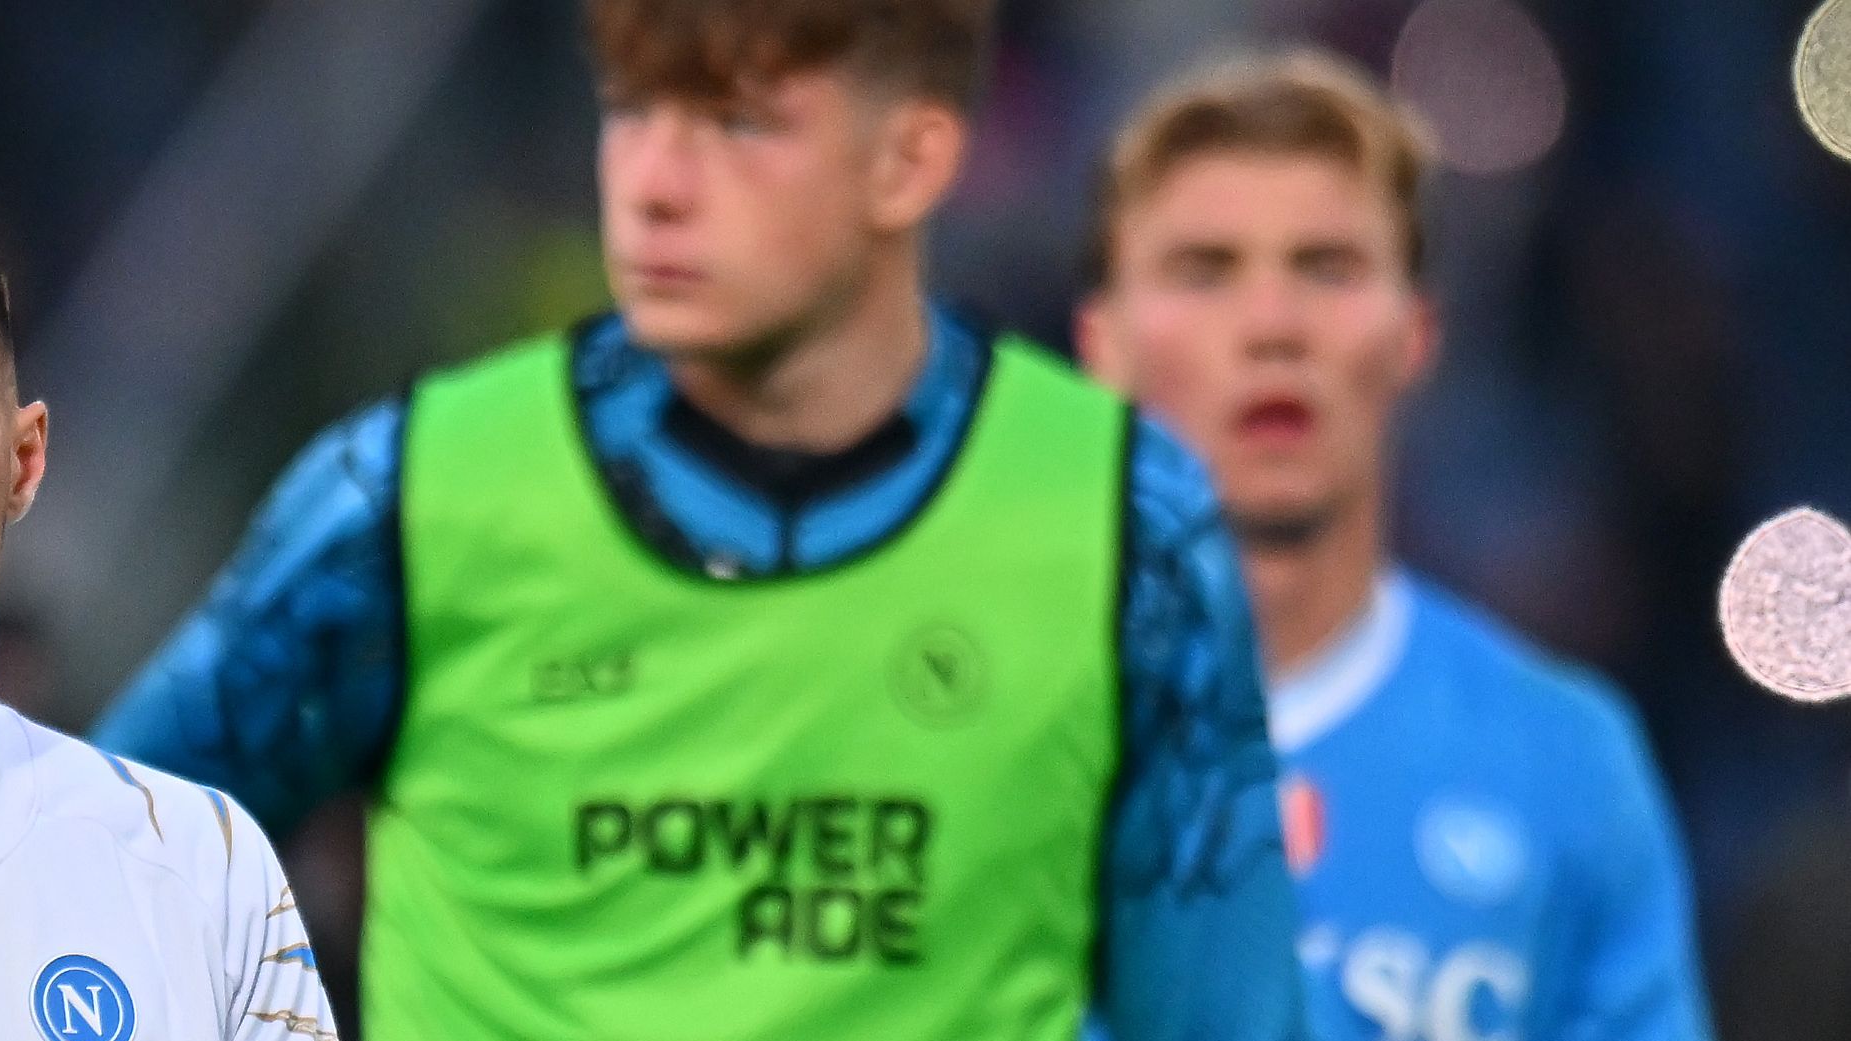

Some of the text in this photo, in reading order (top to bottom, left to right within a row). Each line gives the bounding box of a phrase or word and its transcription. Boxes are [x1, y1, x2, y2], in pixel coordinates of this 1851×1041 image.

[575, 799, 933, 878] POWER
[738, 887, 924, 963] ADE
[57, 984, 102, 1037] N
